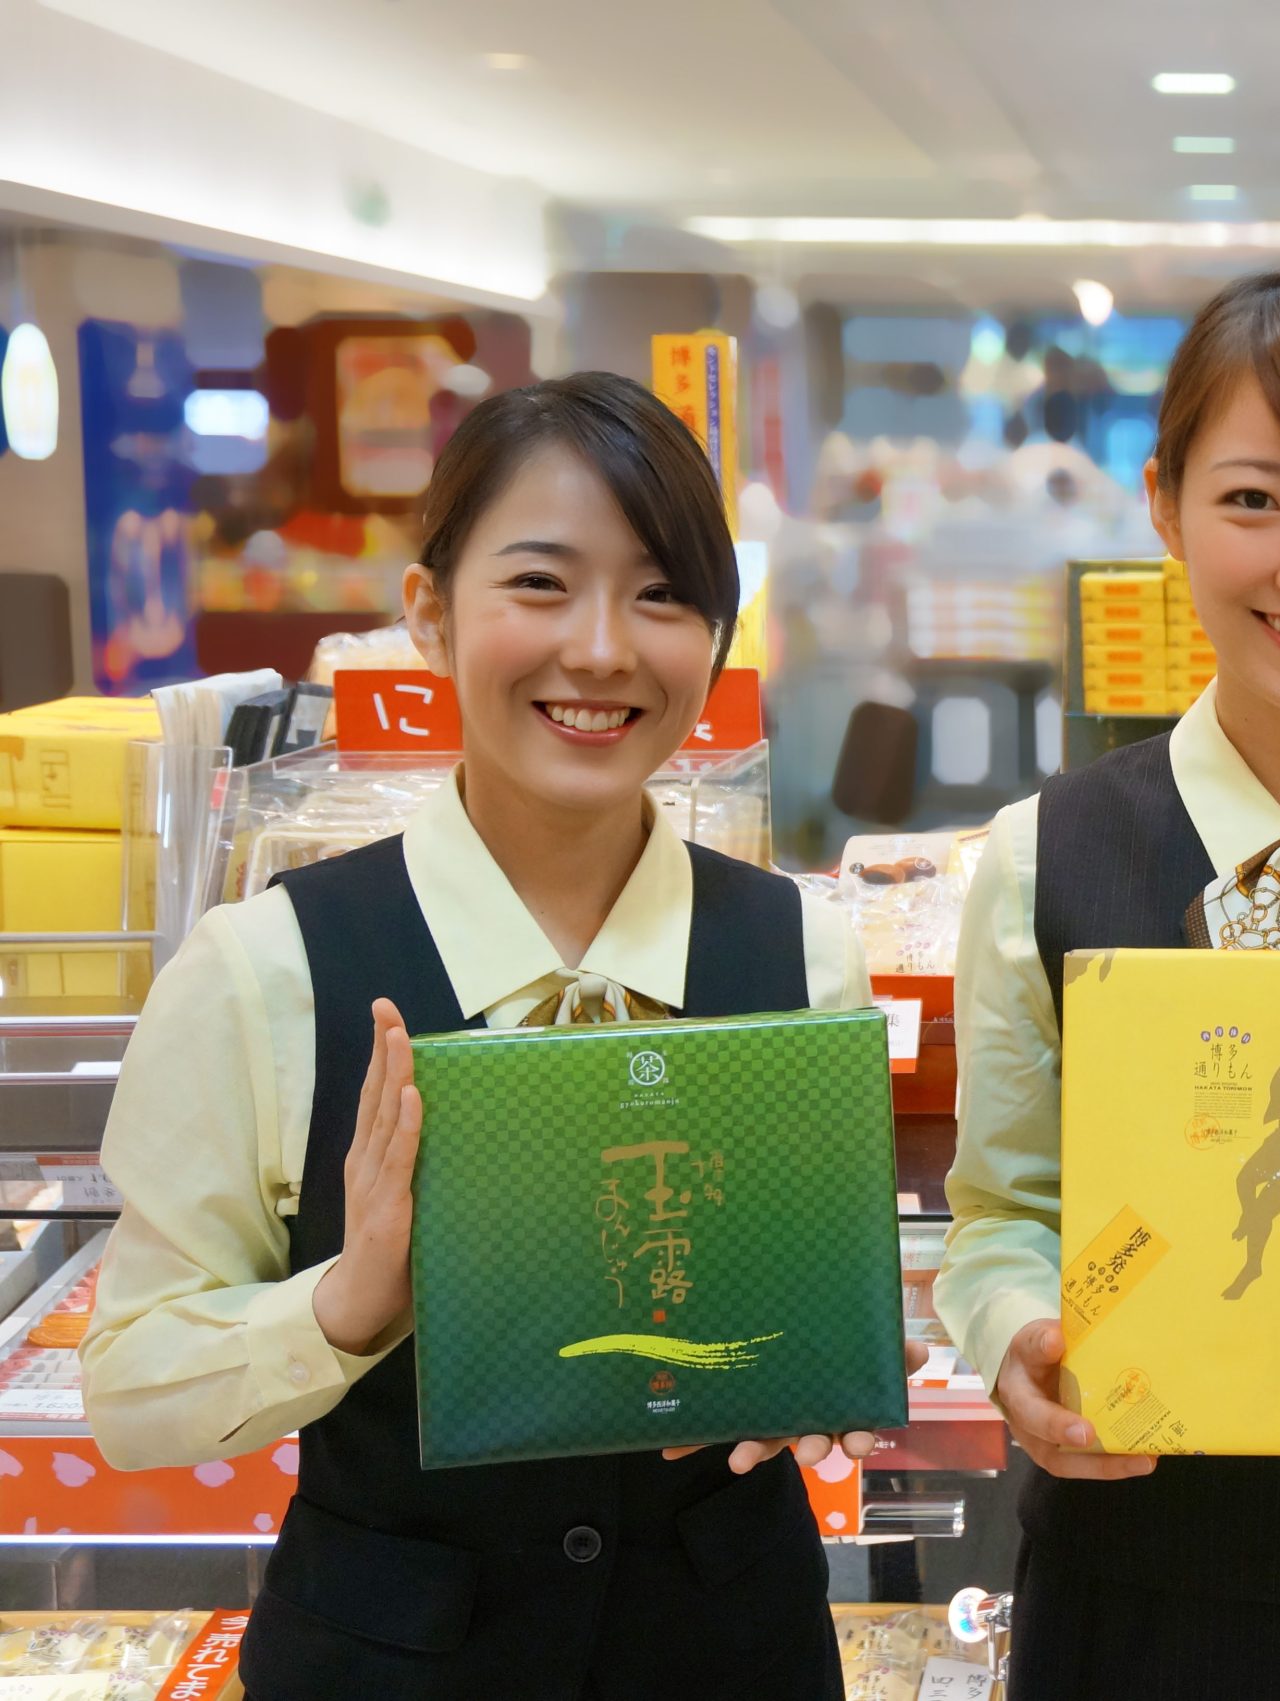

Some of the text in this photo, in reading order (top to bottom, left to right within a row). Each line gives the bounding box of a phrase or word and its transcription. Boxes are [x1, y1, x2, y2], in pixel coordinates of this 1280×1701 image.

[1210, 1042, 1238, 1062] 博多
[1194, 1061, 1253, 1080] 通りもん
[171, 1615, 248, 1701] 今売れてま
